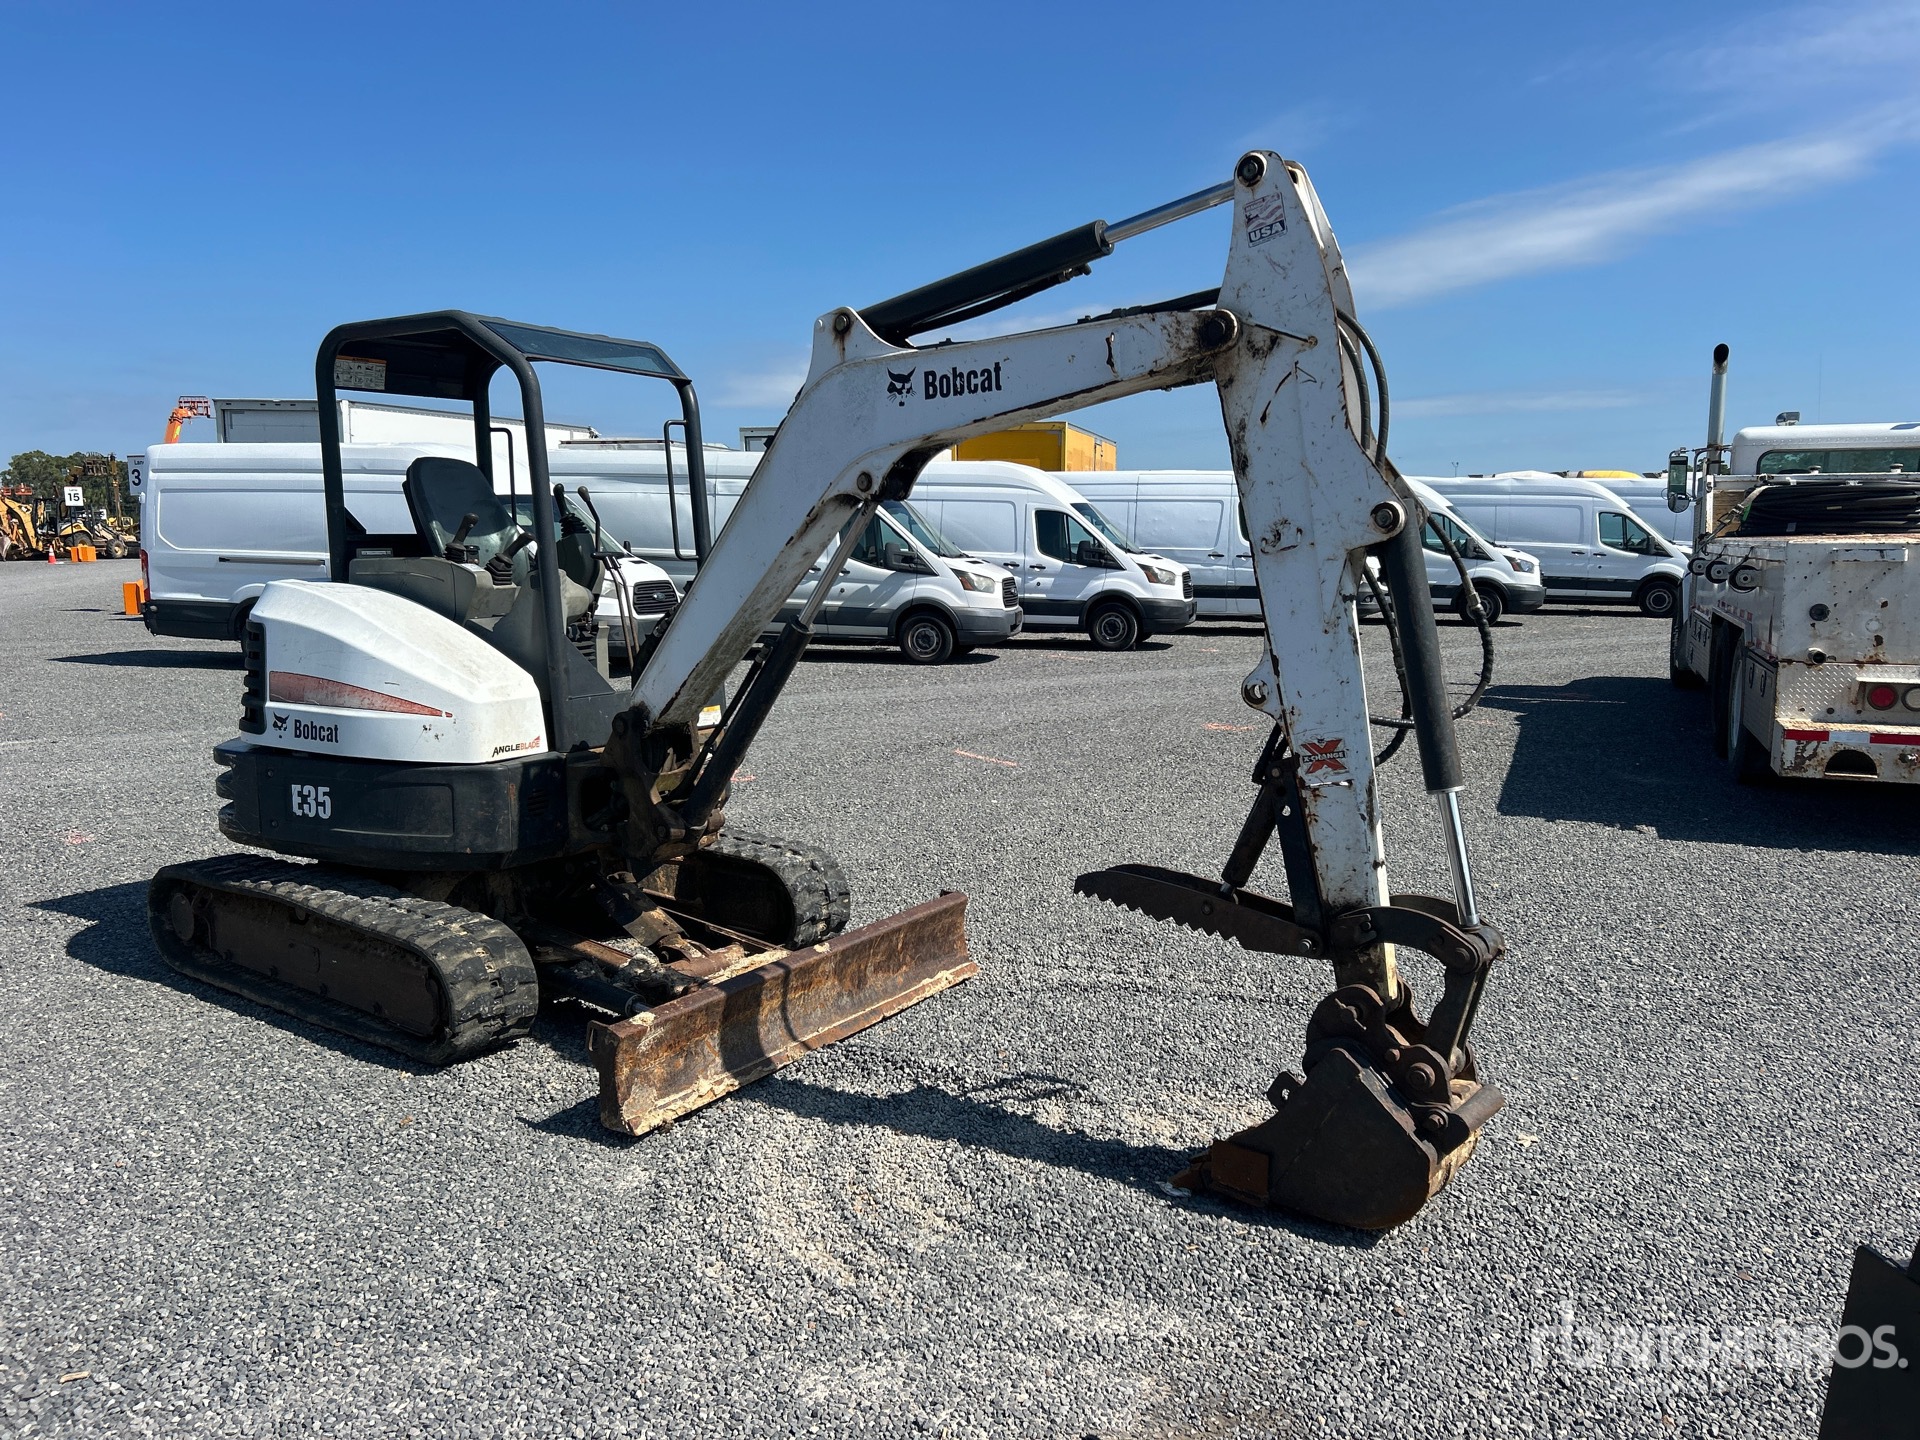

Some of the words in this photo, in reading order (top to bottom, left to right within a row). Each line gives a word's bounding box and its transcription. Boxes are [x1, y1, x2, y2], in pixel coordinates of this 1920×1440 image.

[1250, 222, 1284, 241] USA
[924, 361, 1002, 400] Bobcat
[131, 469, 142, 487] 3
[67, 493, 80, 502] 15
[294, 719, 339, 743] Bobcat
[1303, 752, 1344, 763] X-CHANGE
[292, 784, 332, 819] E35
